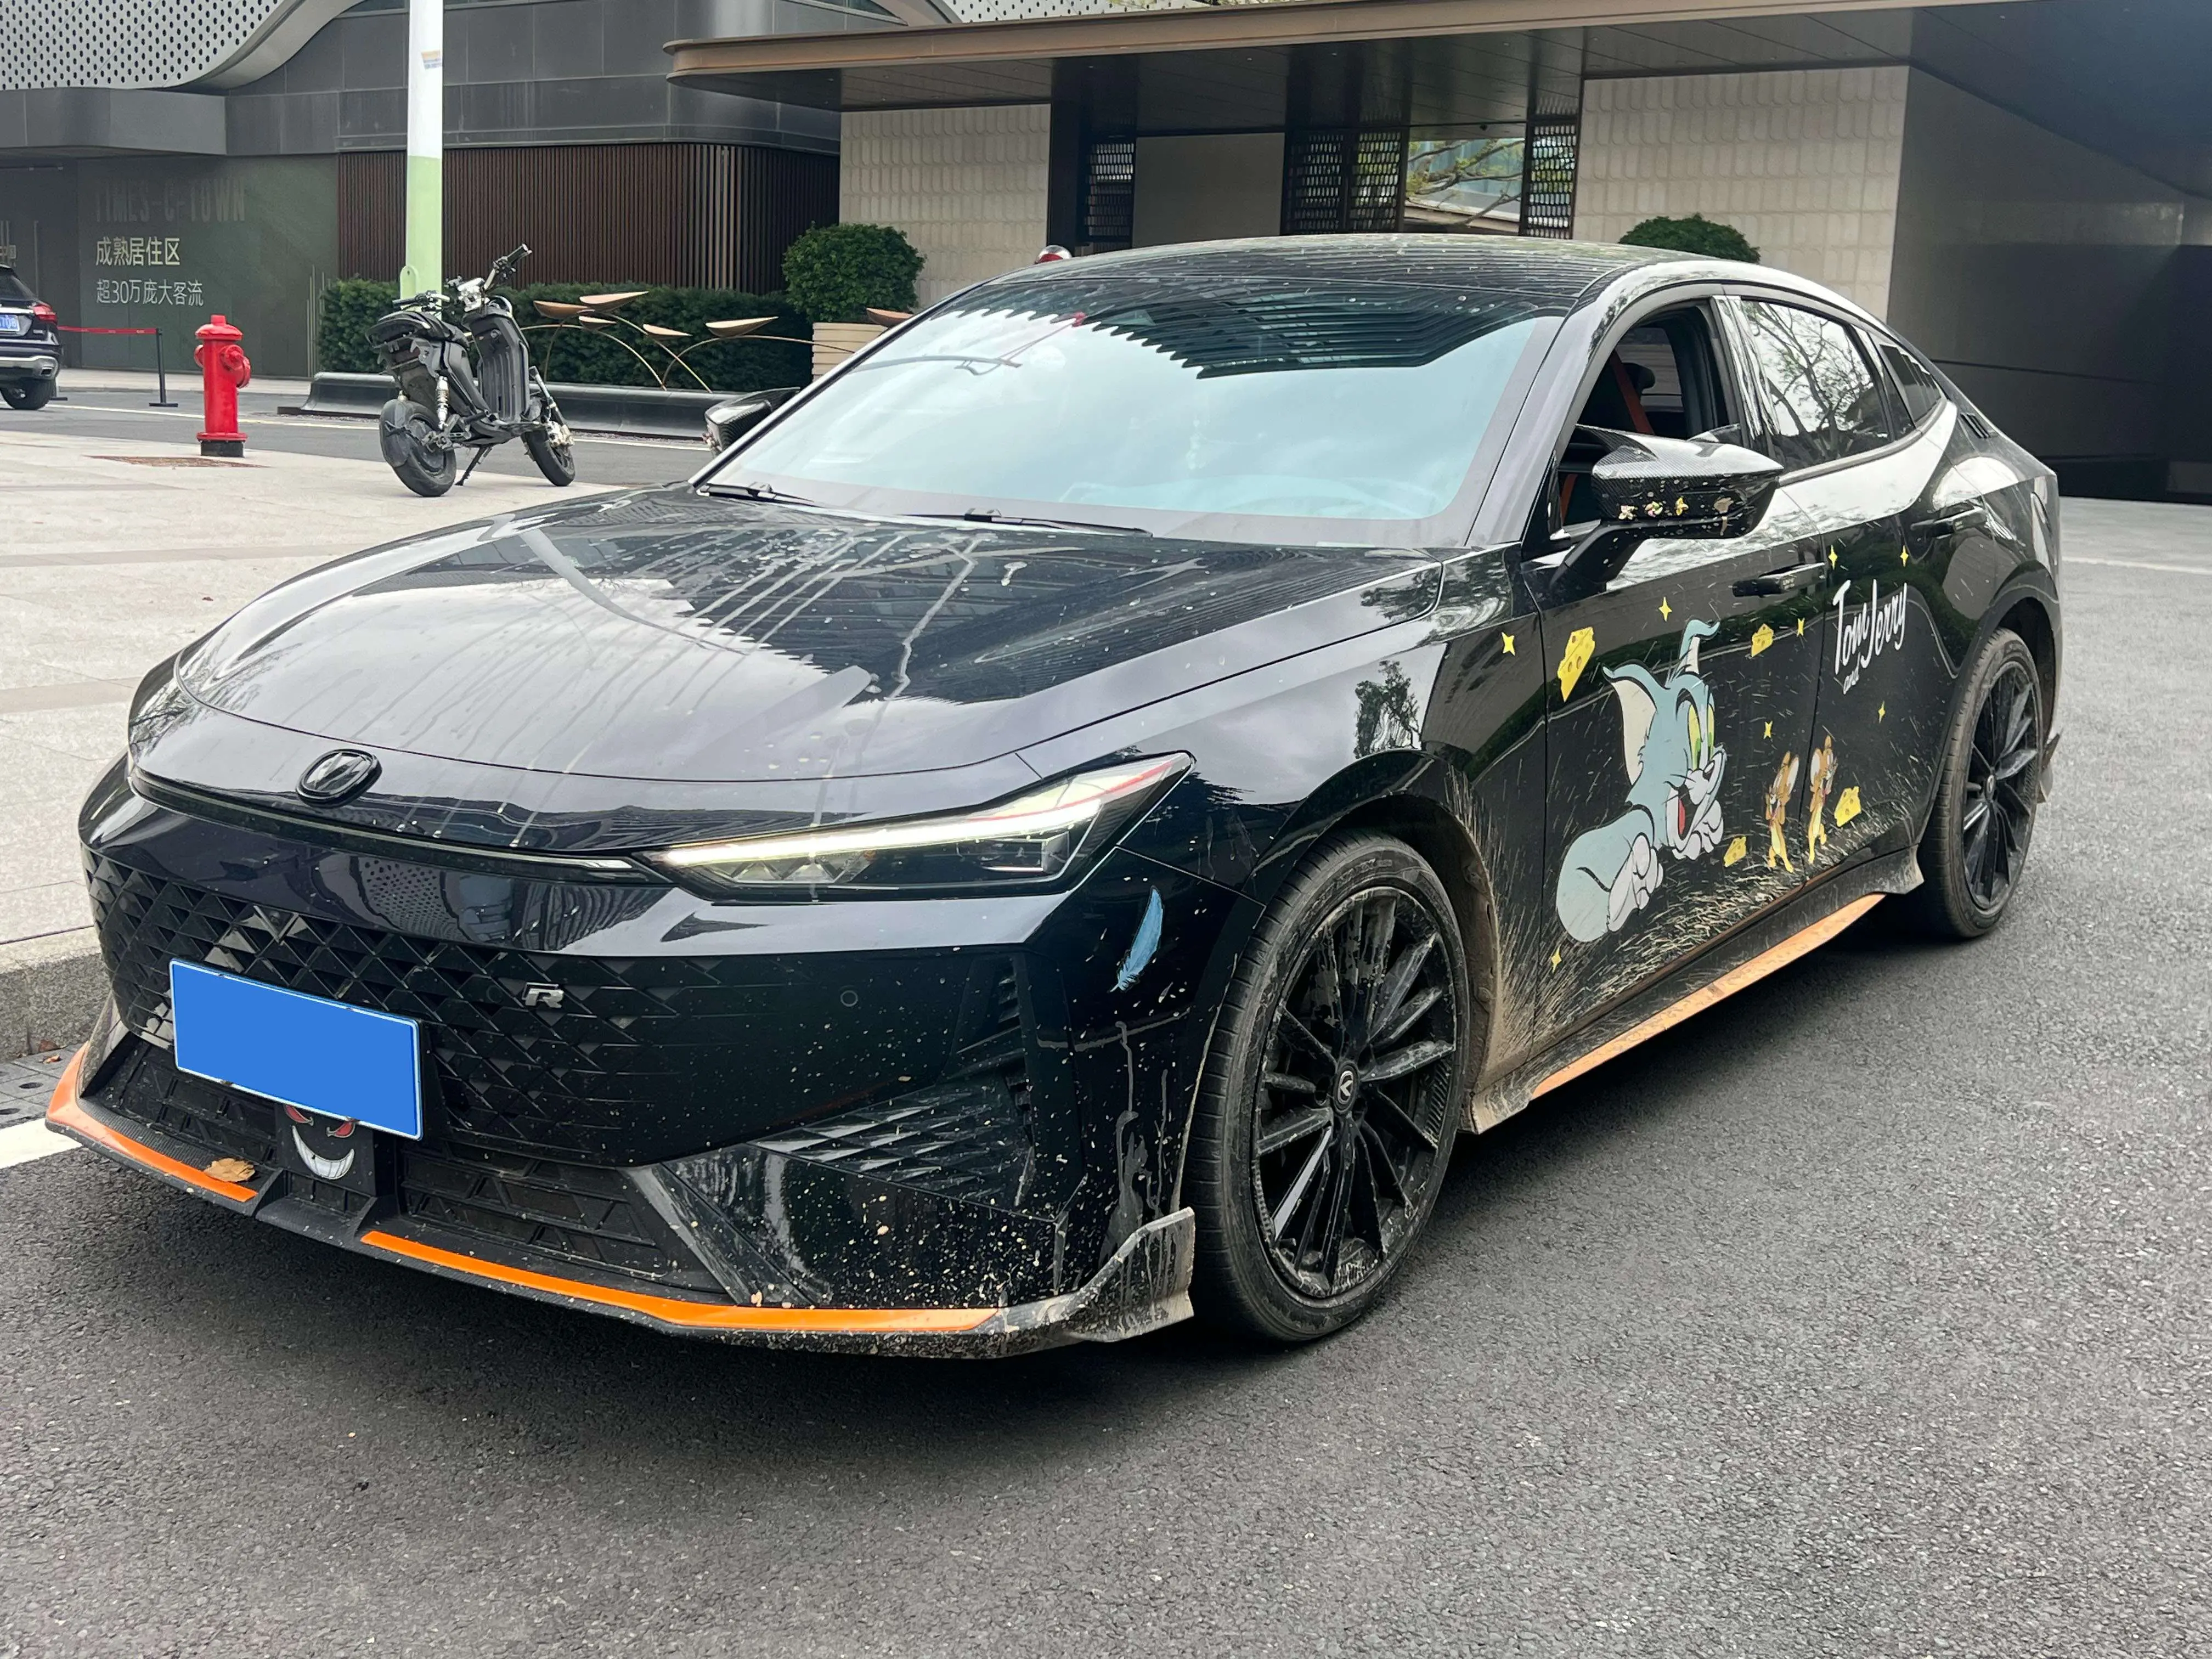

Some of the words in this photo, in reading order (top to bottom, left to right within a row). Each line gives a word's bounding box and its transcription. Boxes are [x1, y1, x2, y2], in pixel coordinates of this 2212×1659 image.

[95, 236, 180, 266] 成熟居住区
[96, 278, 204, 306] 超30万庞大客流
[1832, 579, 1870, 675] Tom
[1860, 579, 1908, 668] Jerry
